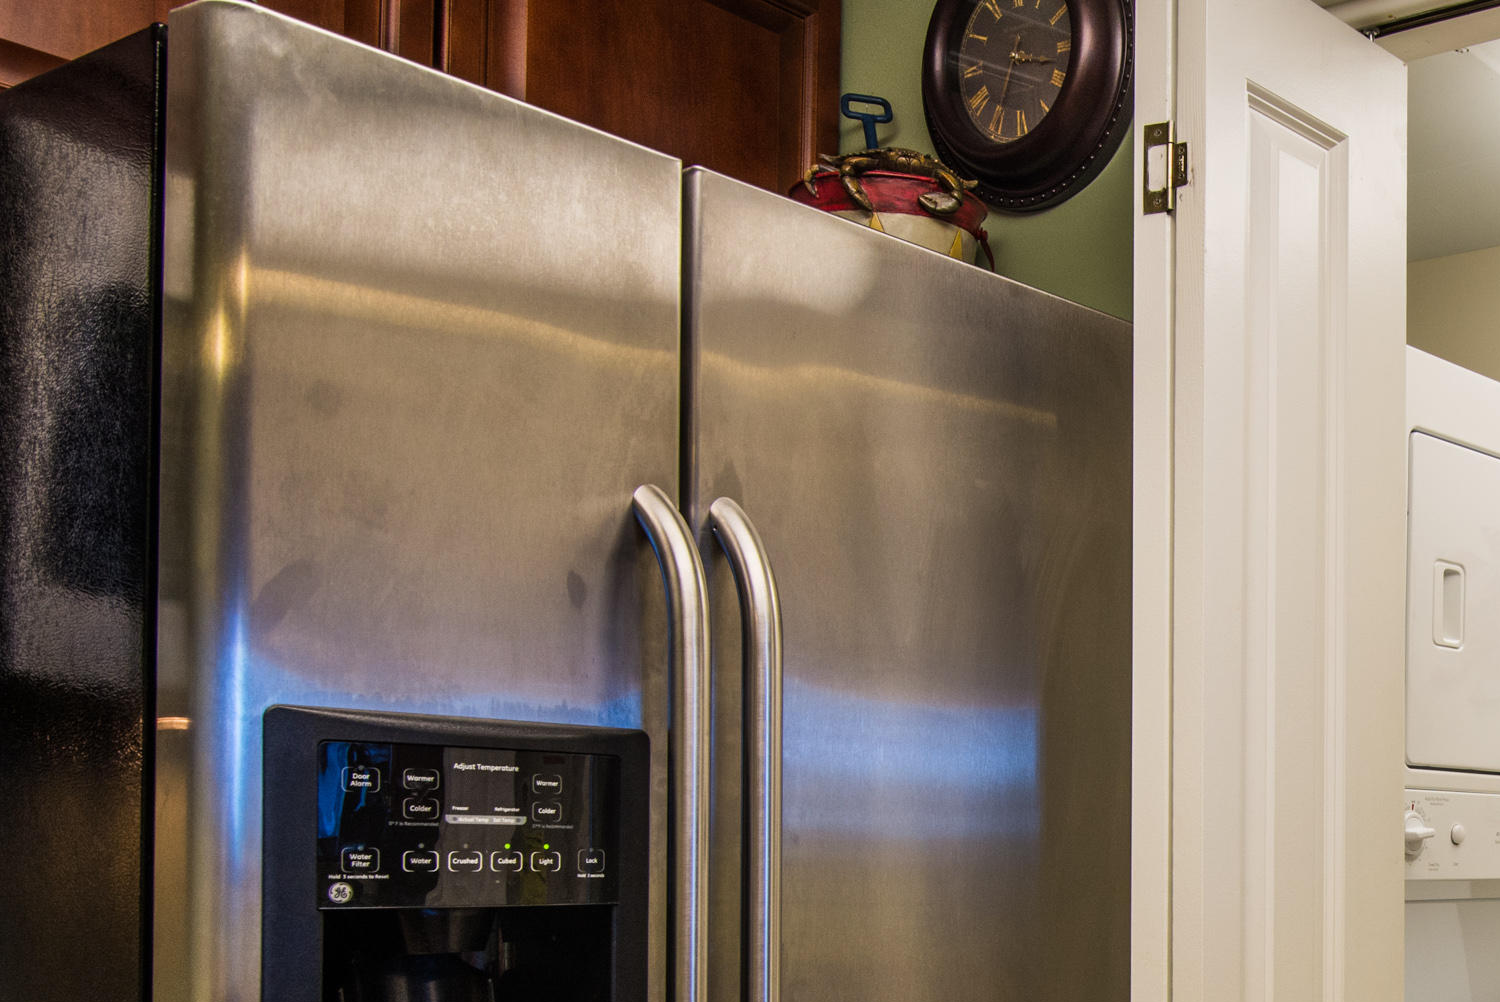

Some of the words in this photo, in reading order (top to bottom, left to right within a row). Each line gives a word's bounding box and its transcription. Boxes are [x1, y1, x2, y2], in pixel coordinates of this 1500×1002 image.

[453, 762, 476, 771] Adjust
[477, 763, 520, 773] Temperature
[539, 858, 554, 866] Light
